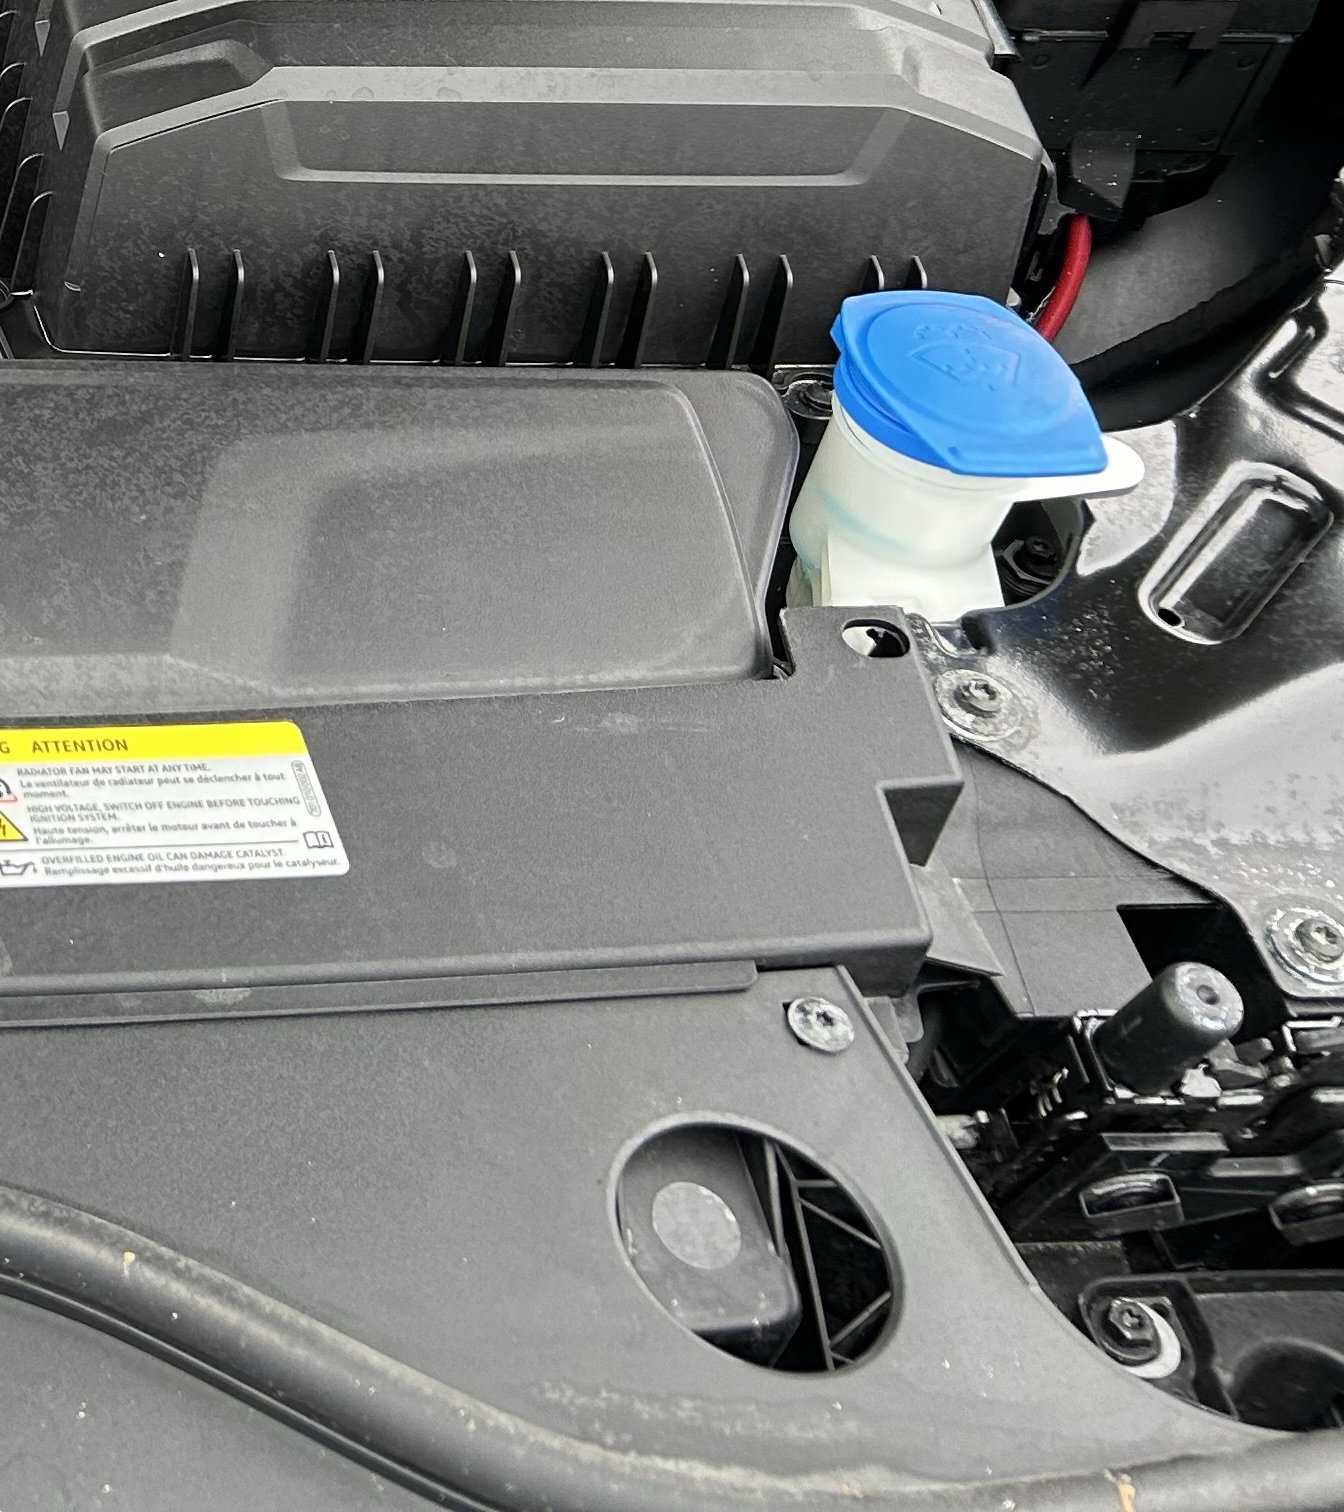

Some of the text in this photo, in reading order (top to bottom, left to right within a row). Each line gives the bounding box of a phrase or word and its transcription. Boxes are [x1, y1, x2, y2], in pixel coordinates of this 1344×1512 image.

[32, 739, 129, 754] ATTENTION
[17, 767, 68, 777] RADIATOR
[70, 767, 90, 776] FAN
[92, 766, 114, 775] MAY
[116, 764, 145, 774] START
[147, 764, 161, 773] AT
[163, 763, 184, 773] ANY
[19, 779, 33, 789] Le
[35, 778, 91, 788] ventilateur
[93, 778, 107, 788] de
[108, 776, 155, 786] radiateur
[158, 776, 181, 787] peut
[183, 776, 195, 784] se
[197, 773, 252, 784] déclencher
[263, 773, 286, 782] tout
[27, 805, 55, 814] HIGH
[105, 802, 144, 812] SWITCH
[145, 801, 164, 811] OFF
[167, 800, 205, 810] ENGINE
[207, 798, 247, 809] BEFORE
[248, 796, 301, 808] TOUCHING
[30, 814, 76, 824] IGNITION
[34, 826, 63, 835] Haute
[150, 822, 159, 832] le
[161, 822, 200, 832] moteur
[202, 821, 230, 830] avant
[233, 820, 246, 829] de
[249, 818, 287, 829] toucher
[42, 855, 104, 865] OVERFILLED
[107, 854, 145, 863] ENGINE
[147, 852, 164, 862] OIL
[167, 852, 188, 862] CAN
[190, 850, 233, 861] DAMAGE
[45, 866, 110, 877] Remplissage
[112, 863, 152, 873] excessif
[154, 862, 190, 872] d'huile
[192, 859, 246, 872] dangereux
[249, 861, 271, 871] pour
[274, 859, 283, 868] le
